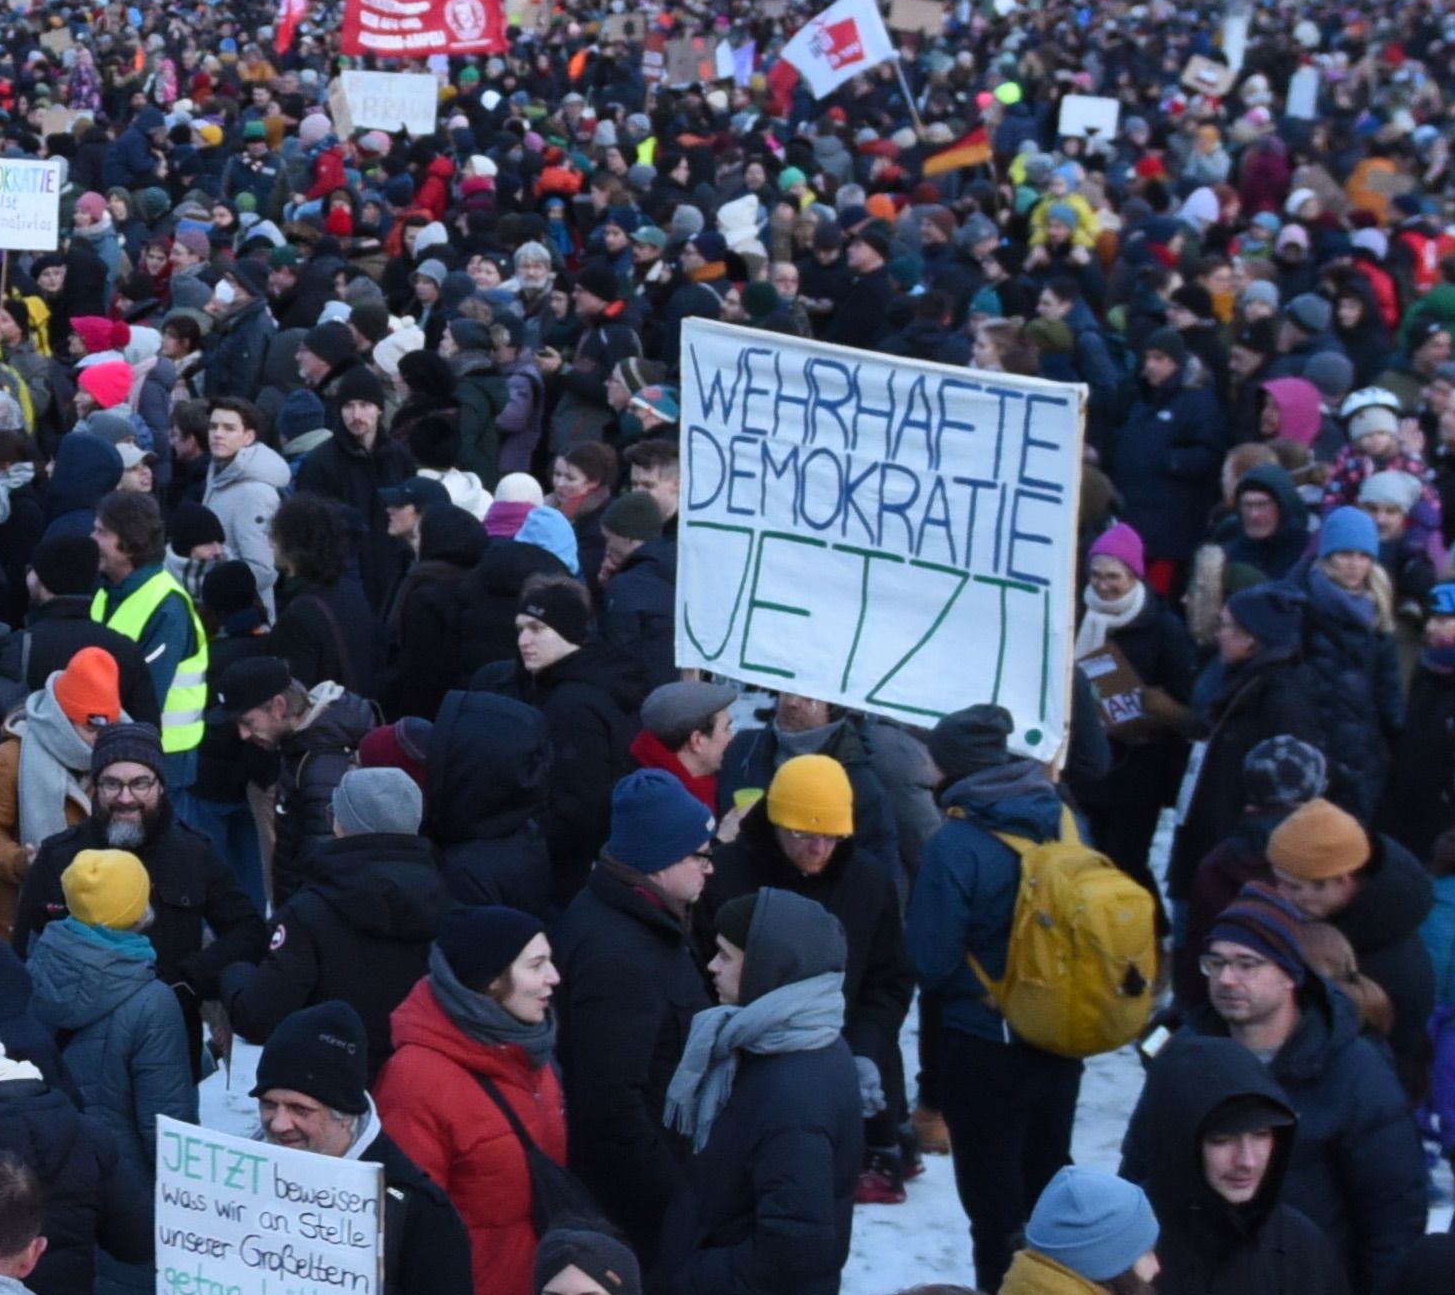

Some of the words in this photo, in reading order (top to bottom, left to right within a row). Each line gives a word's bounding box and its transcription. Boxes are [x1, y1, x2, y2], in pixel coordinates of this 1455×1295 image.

[690, 343, 1069, 492] WEHRHAFTE
[687, 424, 1064, 587] DEMOKRATIE
[162, 1131, 269, 1194] JETZT
[273, 1164, 378, 1214] beweisen
[160, 1223, 233, 1262] unserer
[238, 1233, 370, 1294] Großeltern
[214, 1199, 246, 1225] wir
[259, 1213, 291, 1235] an
[300, 1212, 372, 1249] Stelle
